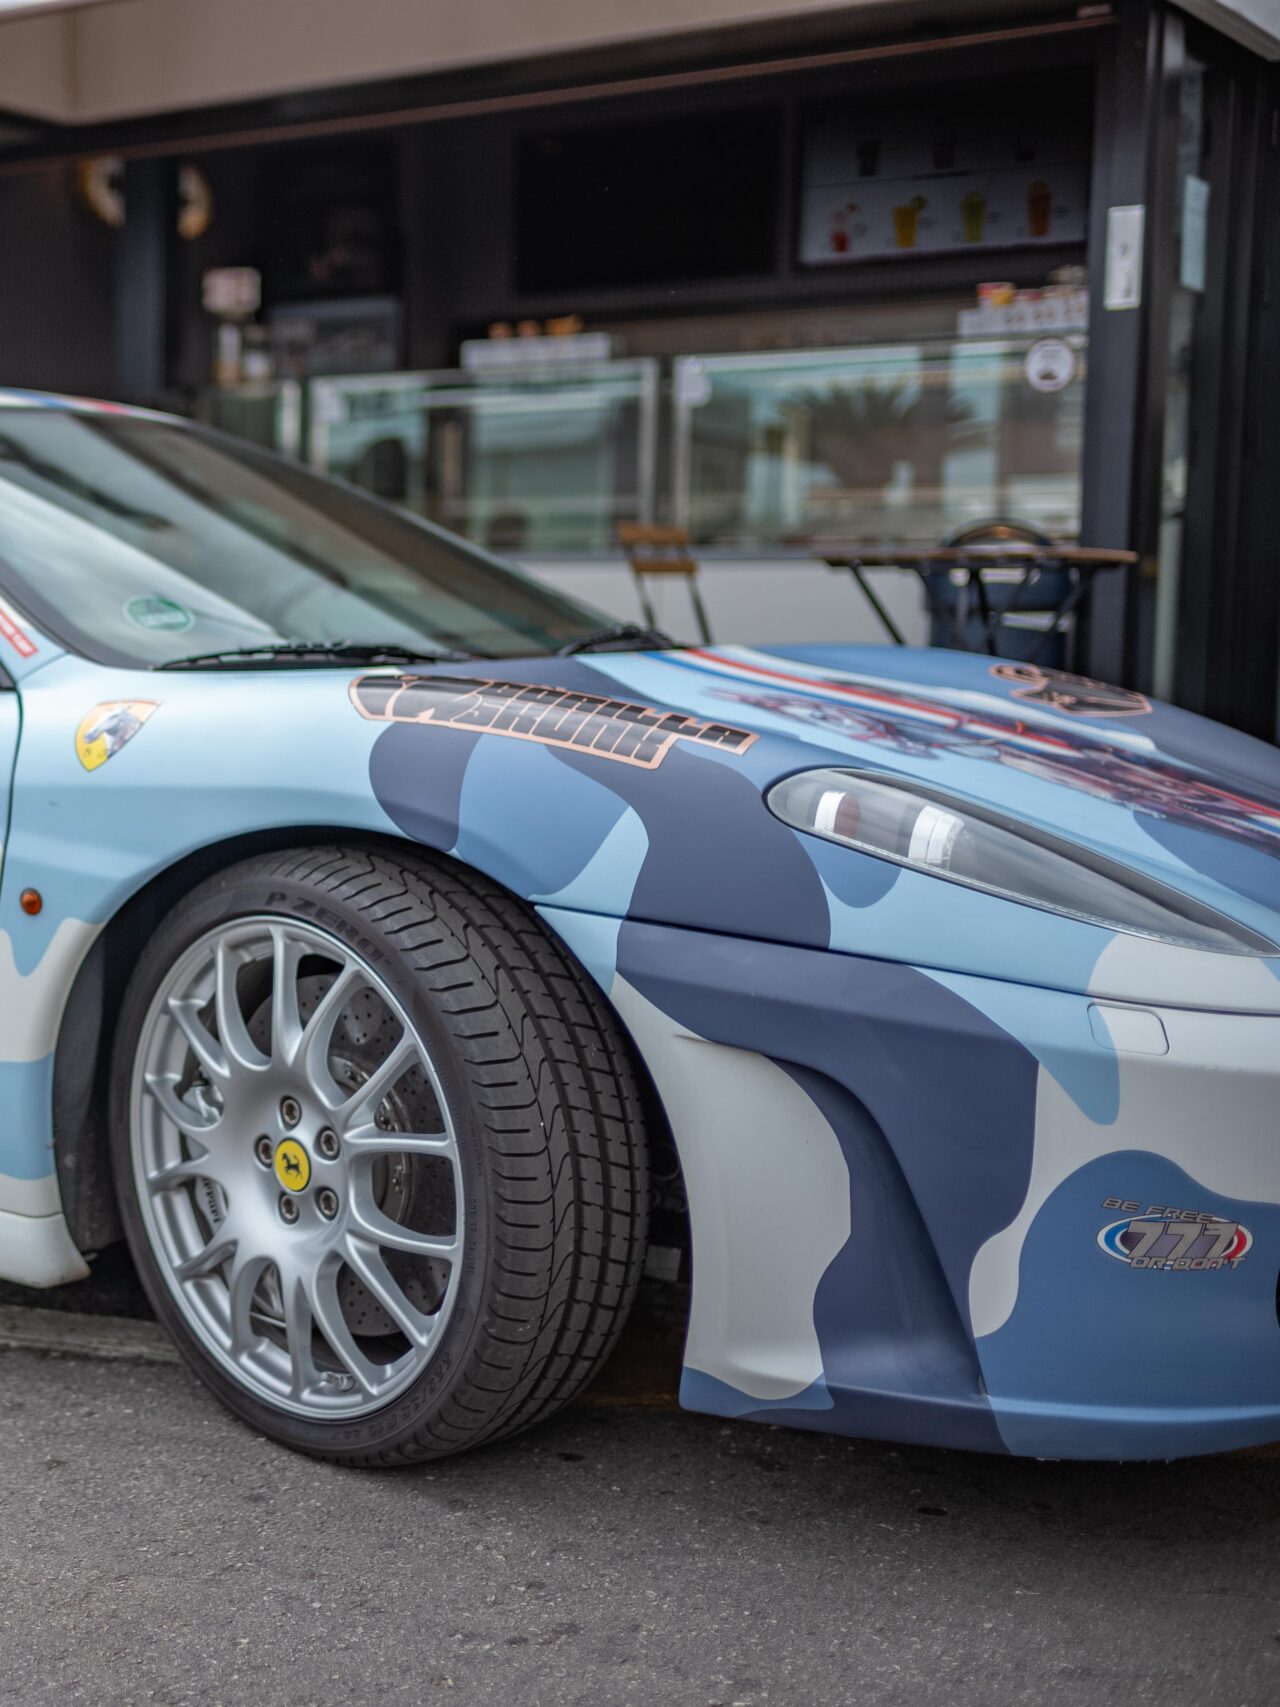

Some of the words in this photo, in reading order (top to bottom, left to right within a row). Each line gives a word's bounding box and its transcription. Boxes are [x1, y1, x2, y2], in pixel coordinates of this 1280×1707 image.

[1102, 1196, 1140, 1213] BE
[1143, 1206, 1216, 1224] FREE
[1127, 1220, 1239, 1259] 777
